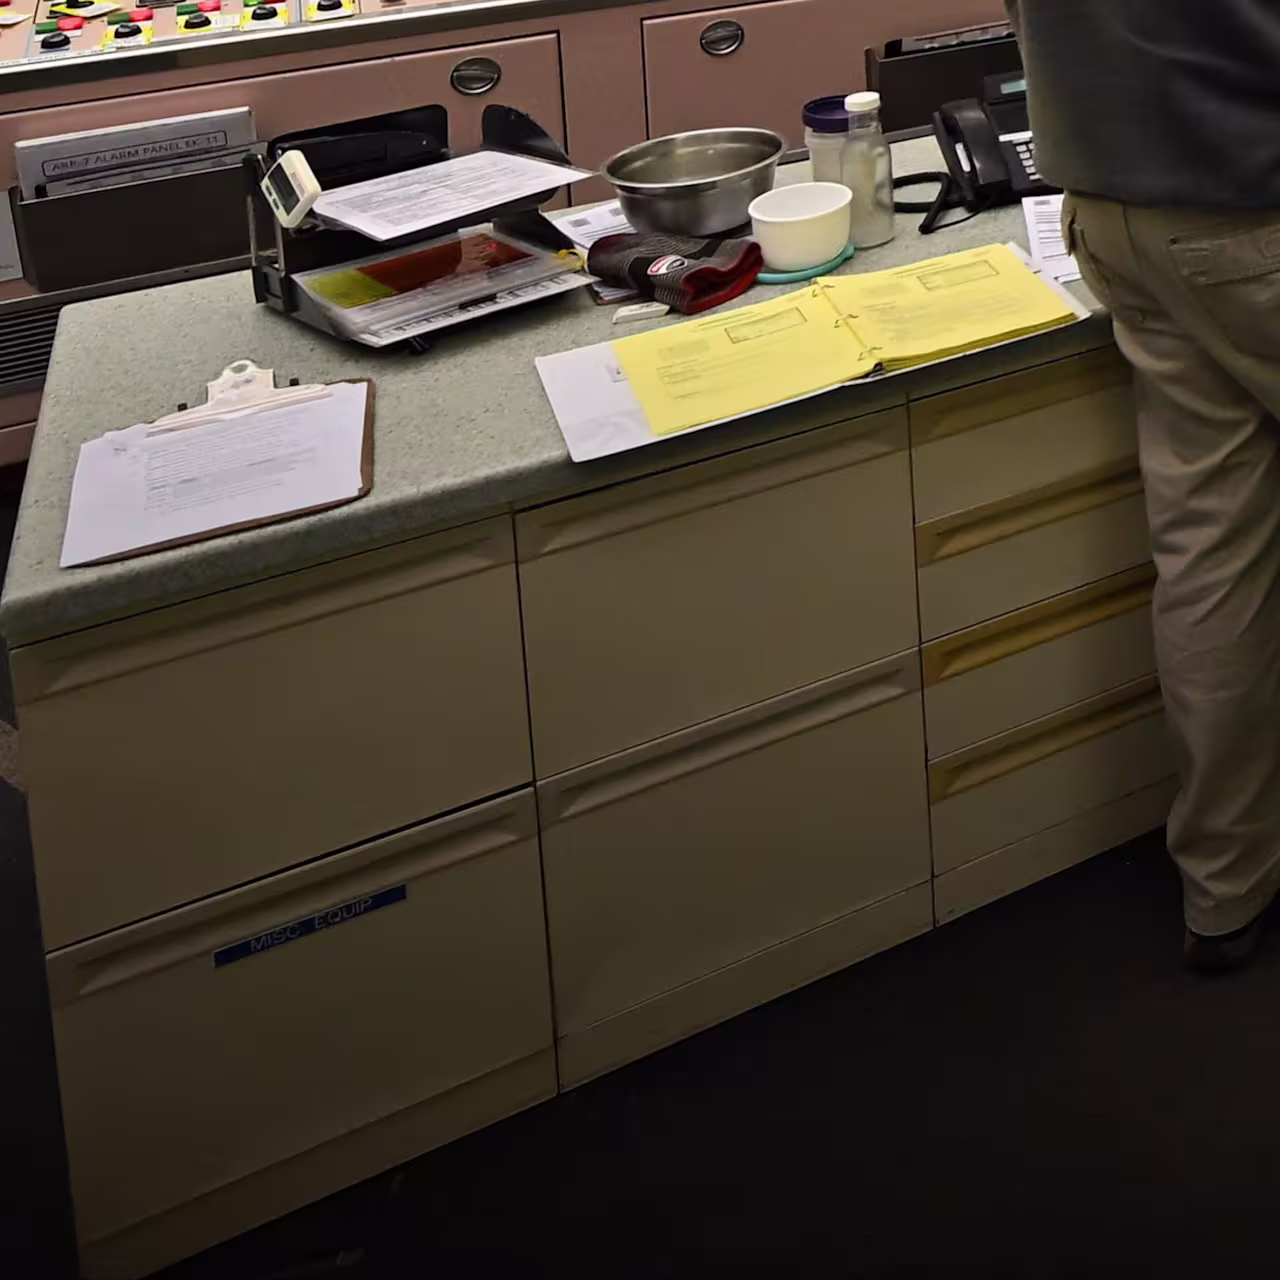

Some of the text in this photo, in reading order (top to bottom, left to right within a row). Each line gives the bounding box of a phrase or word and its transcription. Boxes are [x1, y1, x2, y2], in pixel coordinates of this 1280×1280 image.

[94, 149, 140, 166] ALARM
[143, 142, 182, 159] PANEL
[250, 896, 372, 954] MISC EQUIP
